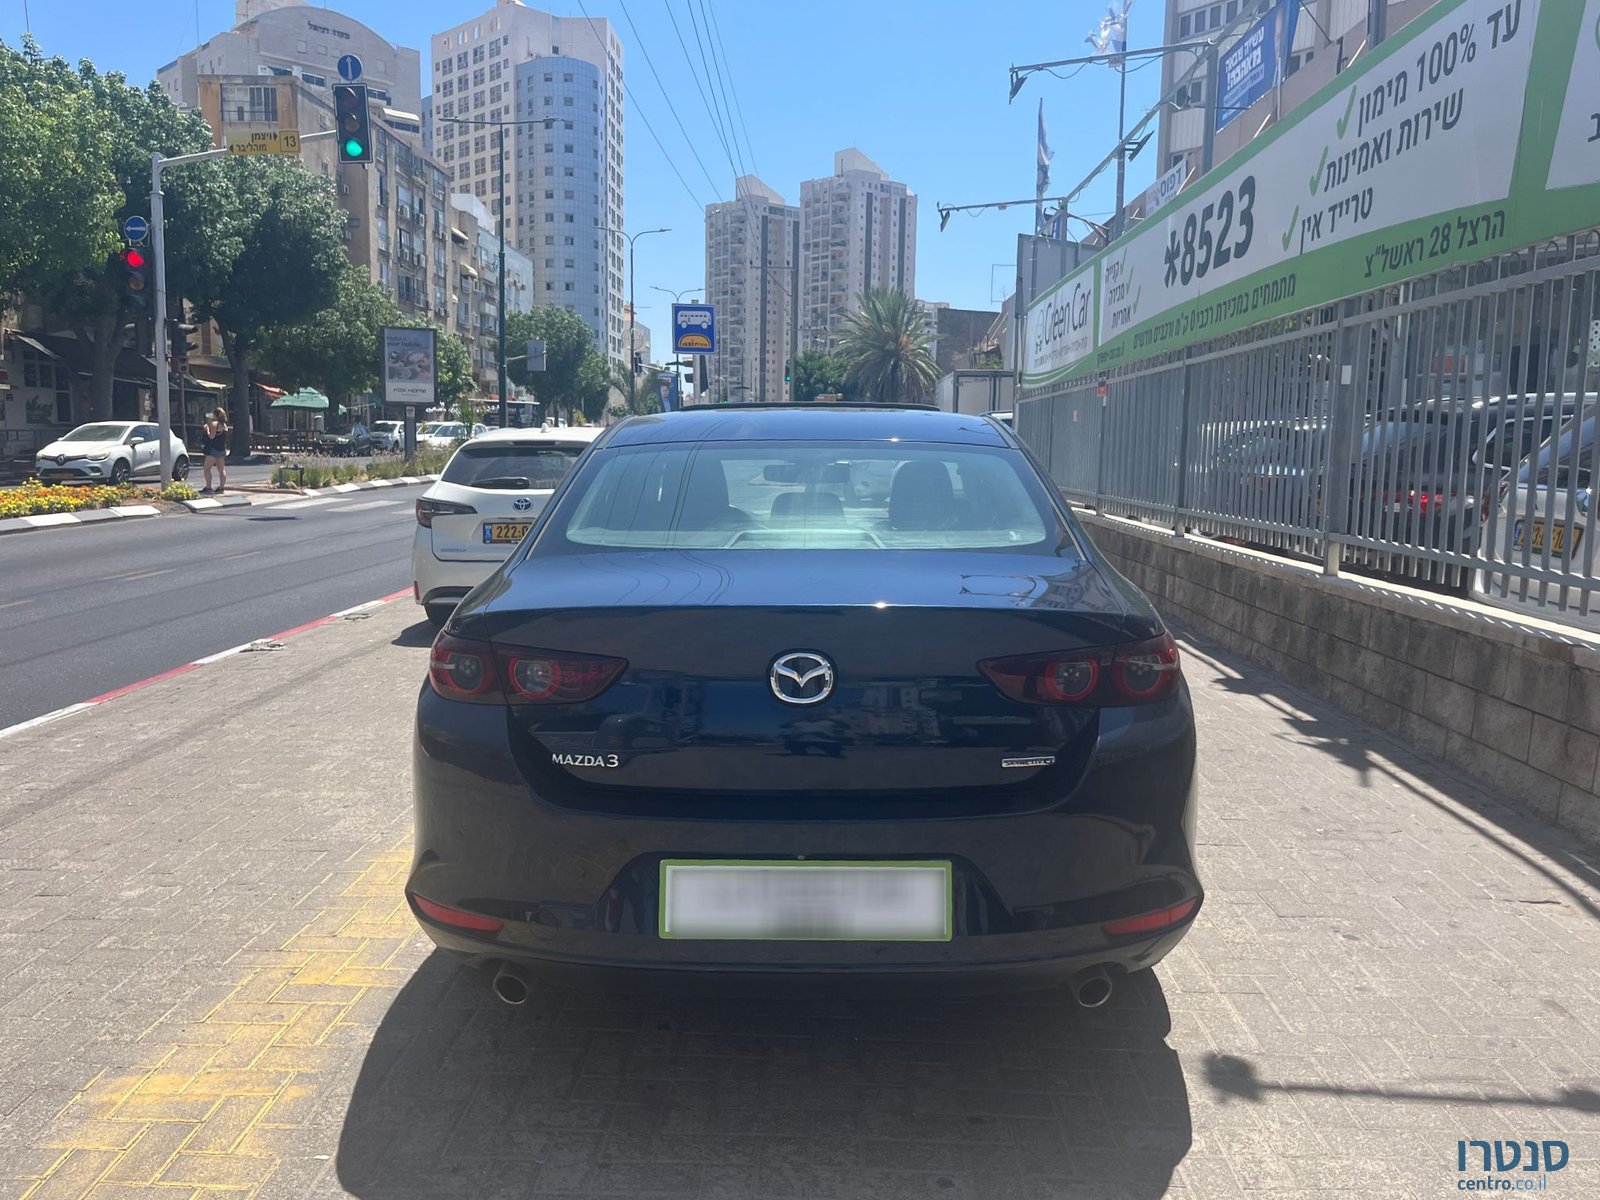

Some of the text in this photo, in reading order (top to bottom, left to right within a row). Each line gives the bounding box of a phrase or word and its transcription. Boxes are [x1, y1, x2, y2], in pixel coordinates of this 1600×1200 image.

[1227, 46, 1262, 91] מאהבה!
[1358, 0, 1521, 137] עד 100% מימון
[235, 141, 267, 152] מוהליבר
[251, 131, 272, 143] ויצמן
[283, 136, 297, 147] 13
[1324, 88, 1464, 192] שירות ואמינות
[1160, 168, 1182, 197] דפוס
[1300, 187, 1373, 255] טרייד אין
[1457, 210, 1505, 250] הרצל
[1429, 222, 1452, 257] 28
[1108, 283, 1125, 306] מכירה
[1215, 293, 1249, 322] במכירת
[1251, 272, 1296, 310] מתמחים
[1044, 283, 1091, 345] Green Car
